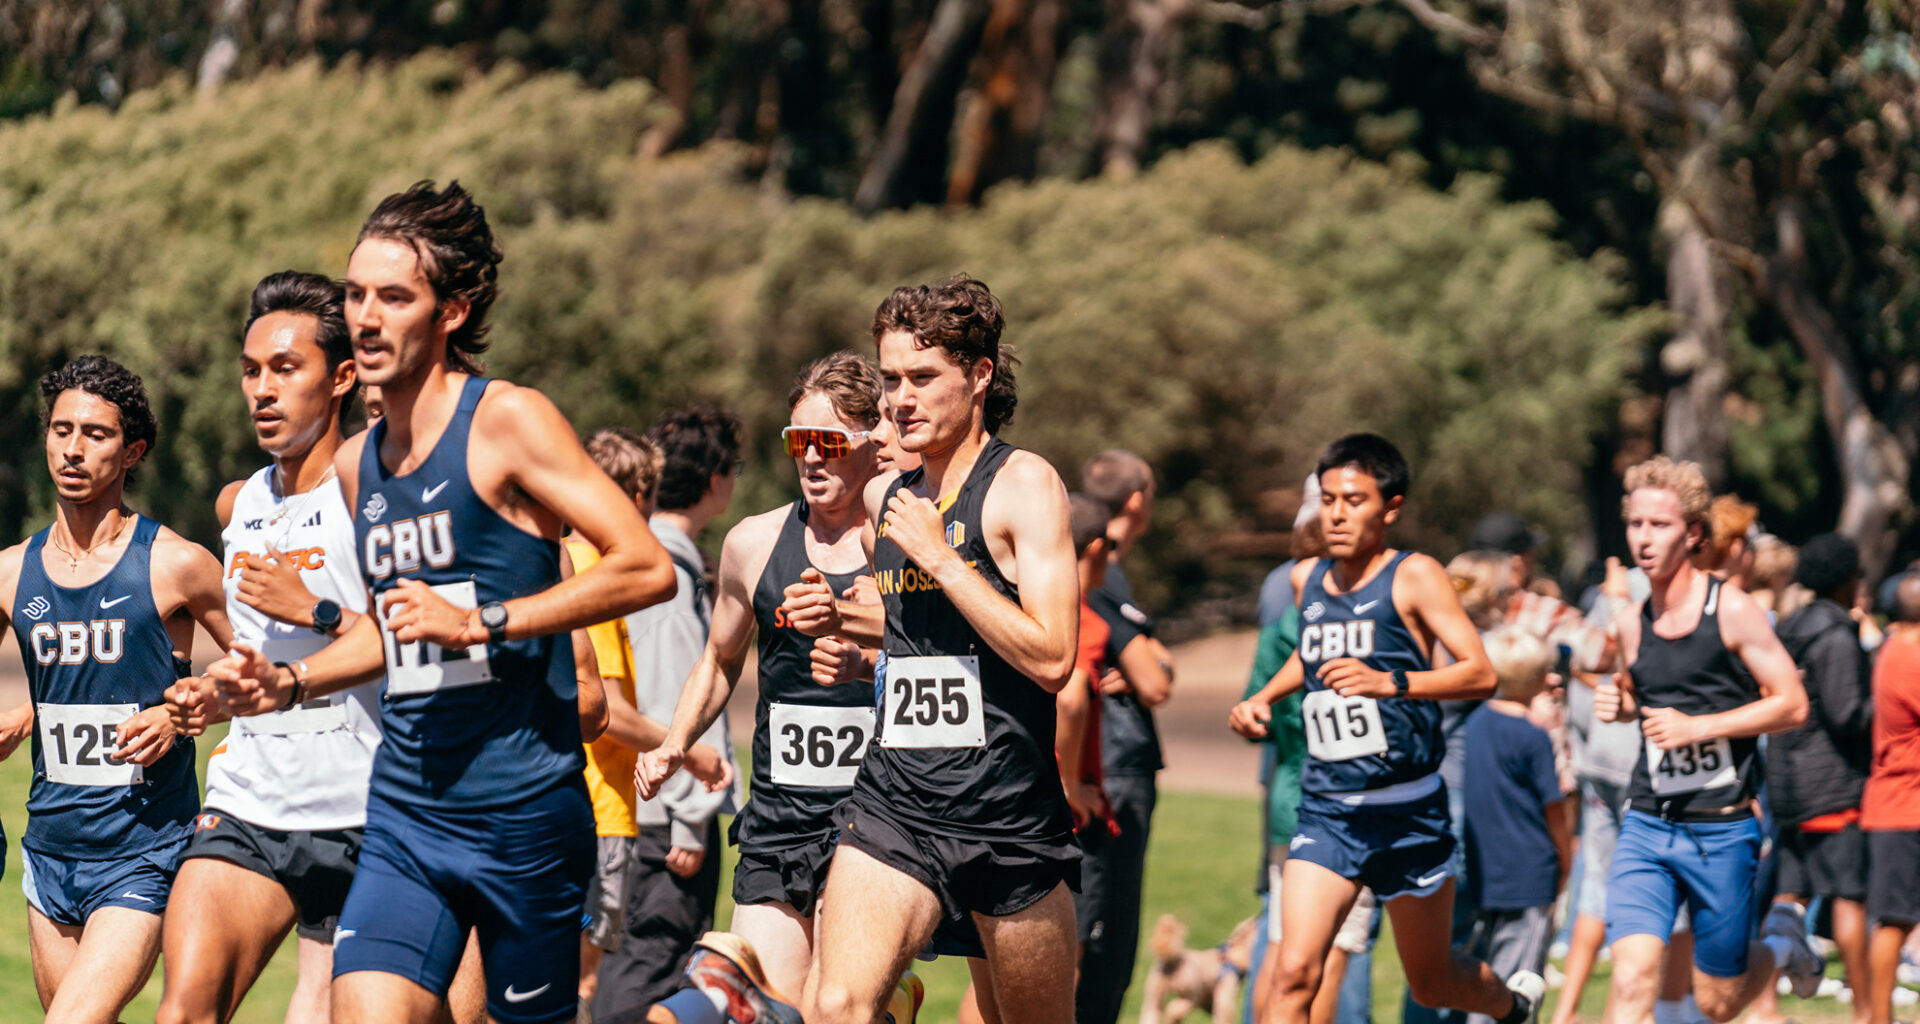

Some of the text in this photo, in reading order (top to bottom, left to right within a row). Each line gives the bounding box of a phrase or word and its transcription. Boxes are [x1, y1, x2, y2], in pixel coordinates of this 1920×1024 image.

[243, 518, 264, 531] WCC
[365, 510, 455, 579] CBU
[30, 619, 125, 666] CBU
[1301, 619, 1375, 663] CBU
[893, 677, 969, 726] 255
[1311, 703, 1369, 743] 115
[49, 723, 128, 766] 125
[781, 723, 864, 768] 362
[1659, 741, 1720, 777] 435
